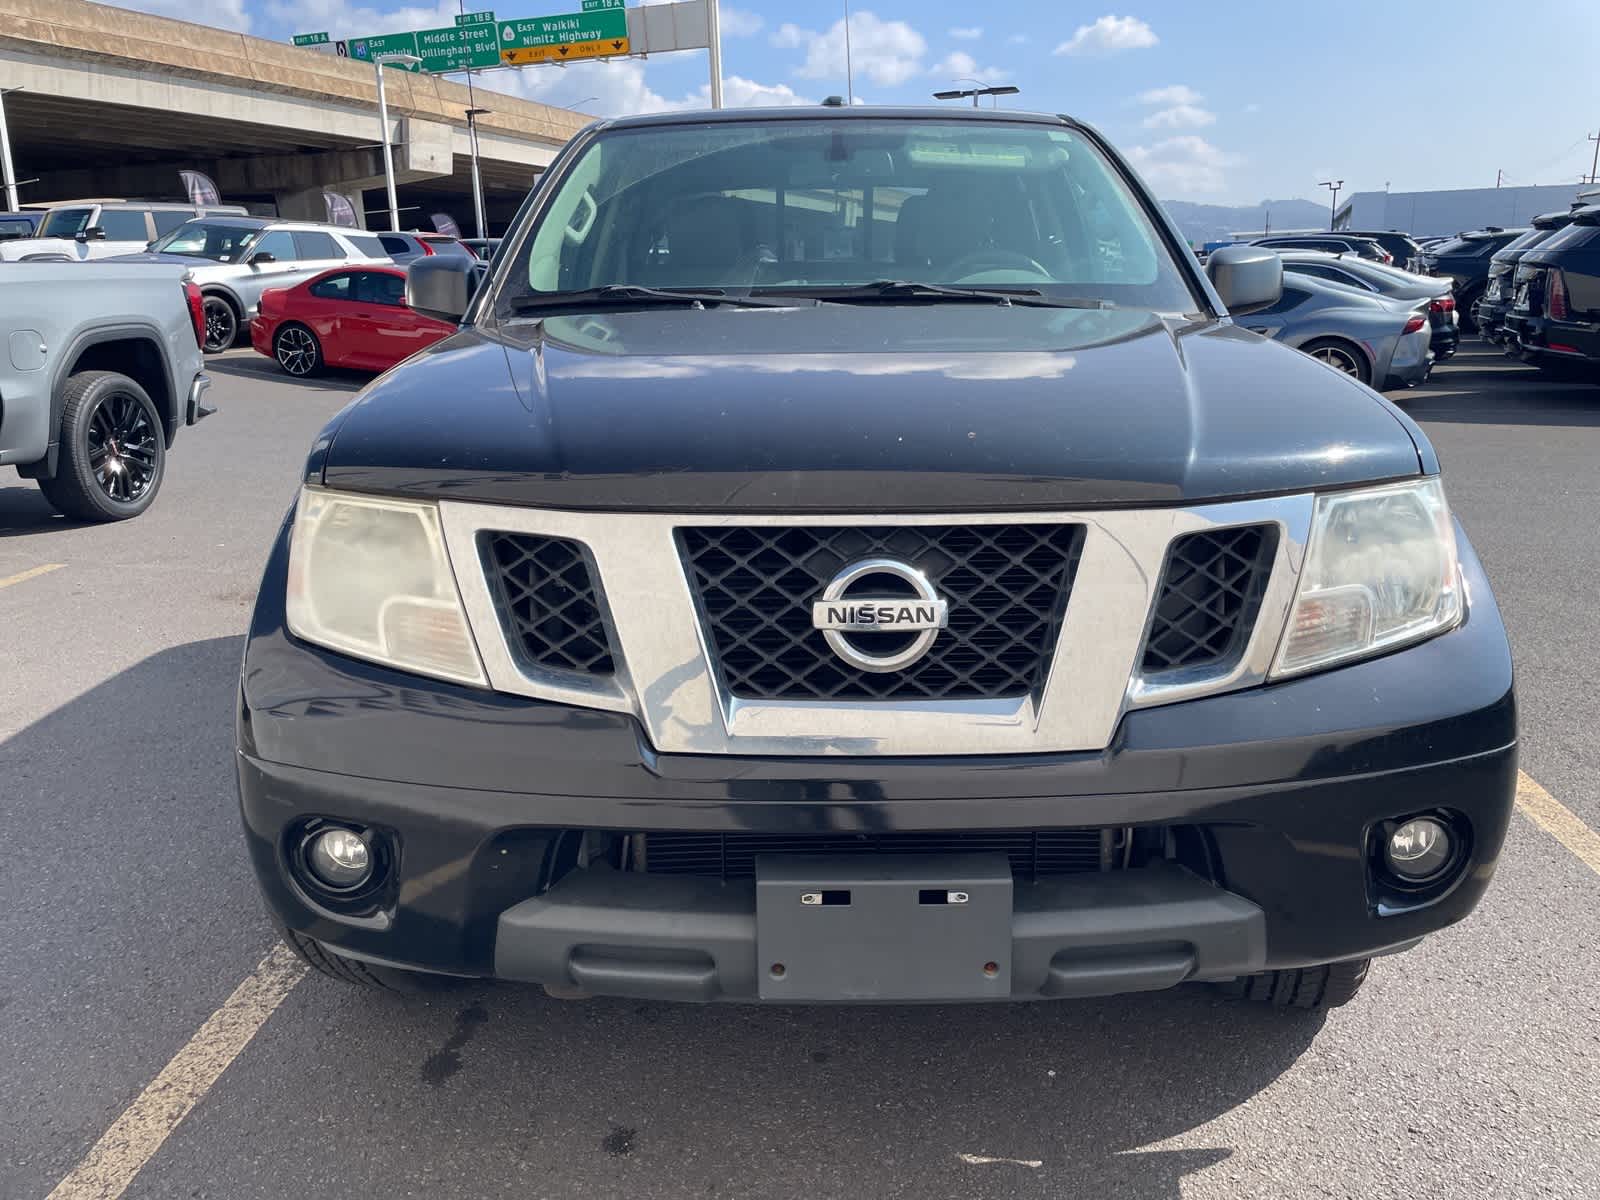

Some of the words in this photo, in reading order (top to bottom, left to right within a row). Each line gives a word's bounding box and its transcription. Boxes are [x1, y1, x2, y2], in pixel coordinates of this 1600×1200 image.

[517, 24, 535, 32] EAST
[542, 19, 580, 32] Waikiki
[369, 39, 385, 48] EAST
[423, 33, 455, 44] Middle
[460, 28, 489, 40] Street
[523, 33, 555, 46] Nimitz
[559, 29, 602, 43] Highway
[420, 45, 472, 58] Dillingham
[475, 41, 497, 53] Blvd
[828, 604, 935, 624] NISSAN
